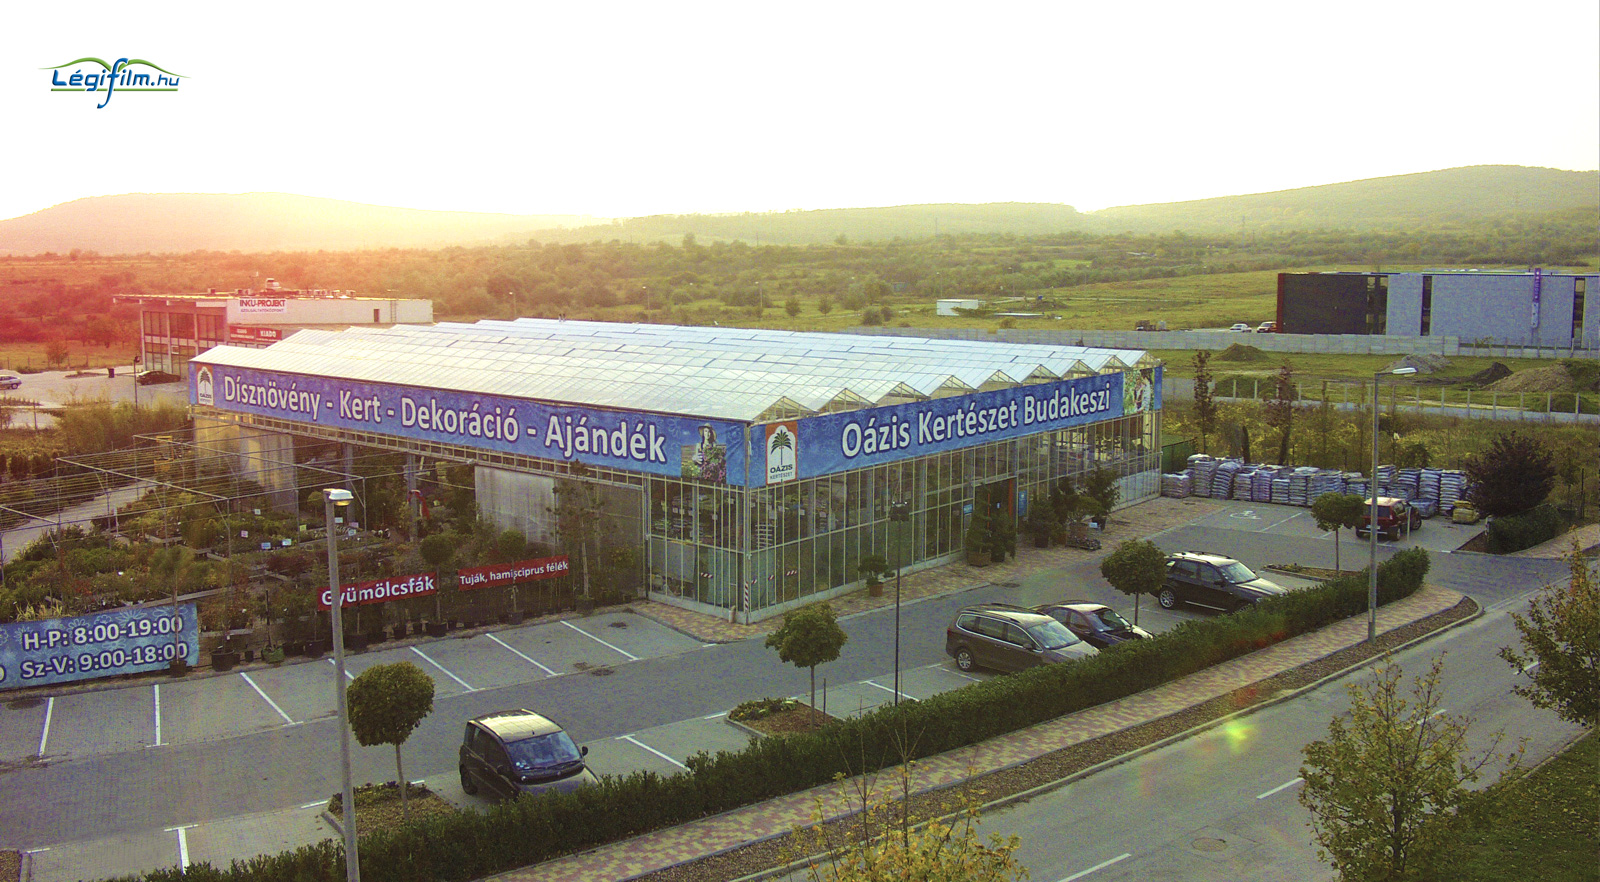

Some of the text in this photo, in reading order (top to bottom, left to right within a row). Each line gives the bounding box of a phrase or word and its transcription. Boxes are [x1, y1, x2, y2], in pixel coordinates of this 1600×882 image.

[240, 299, 286, 307] INKU-PROJEKT
[224, 375, 321, 420] Dísznövény
[339, 390, 381, 423] Kert
[387, 408, 395, 416] -
[401, 397, 519, 441] Dekoráció
[545, 415, 666, 462] Ajándék
[842, 383, 1110, 457] Oázis Kertészet Budakeszi
[770, 464, 793, 473] OÁZIS
[460, 561, 568, 585] Tuják, hamisciprus félék
[25, 616, 183, 649] H-P: 8:00-19:00
[23, 657, 74, 678] Sz-V:
[80, 643, 188, 671] 9:00-18:00
